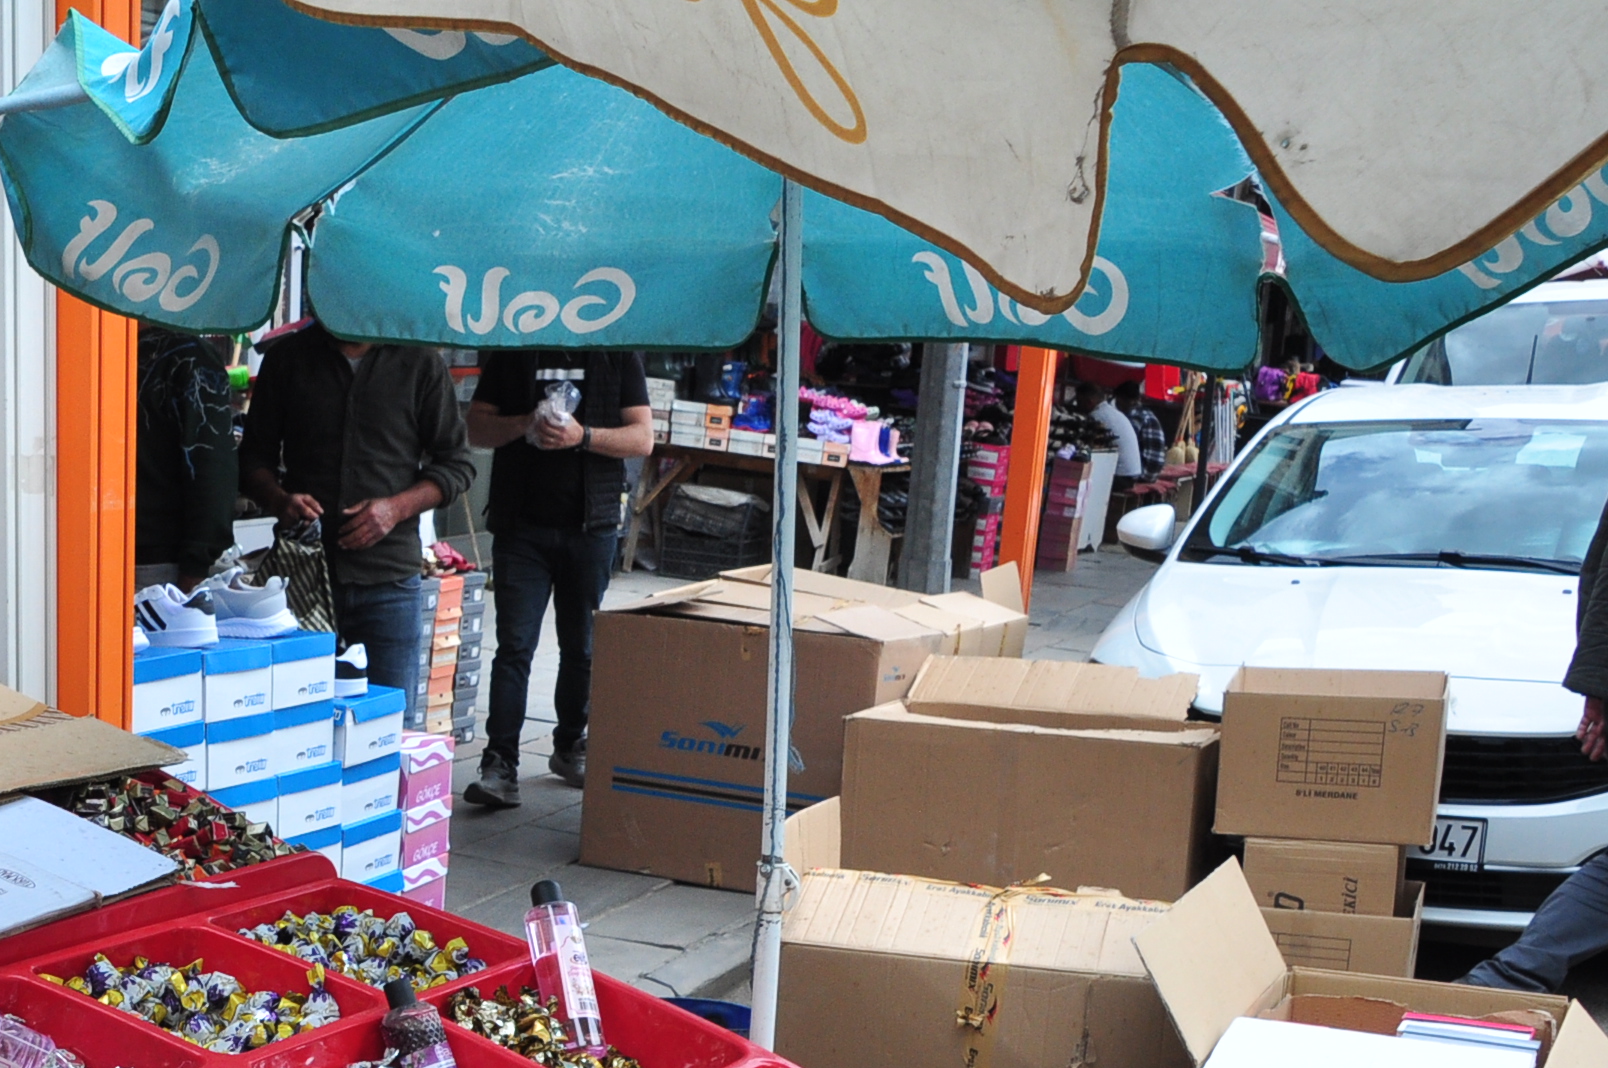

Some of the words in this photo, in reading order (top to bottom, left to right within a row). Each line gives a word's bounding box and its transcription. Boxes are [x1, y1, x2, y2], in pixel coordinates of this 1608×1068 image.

[658, 730, 766, 762] Sonimi
[415, 784, 441, 802] GÖKÇE
[1313, 790, 1359, 800] MERDANE
[412, 842, 438, 861] GÖKÇE
